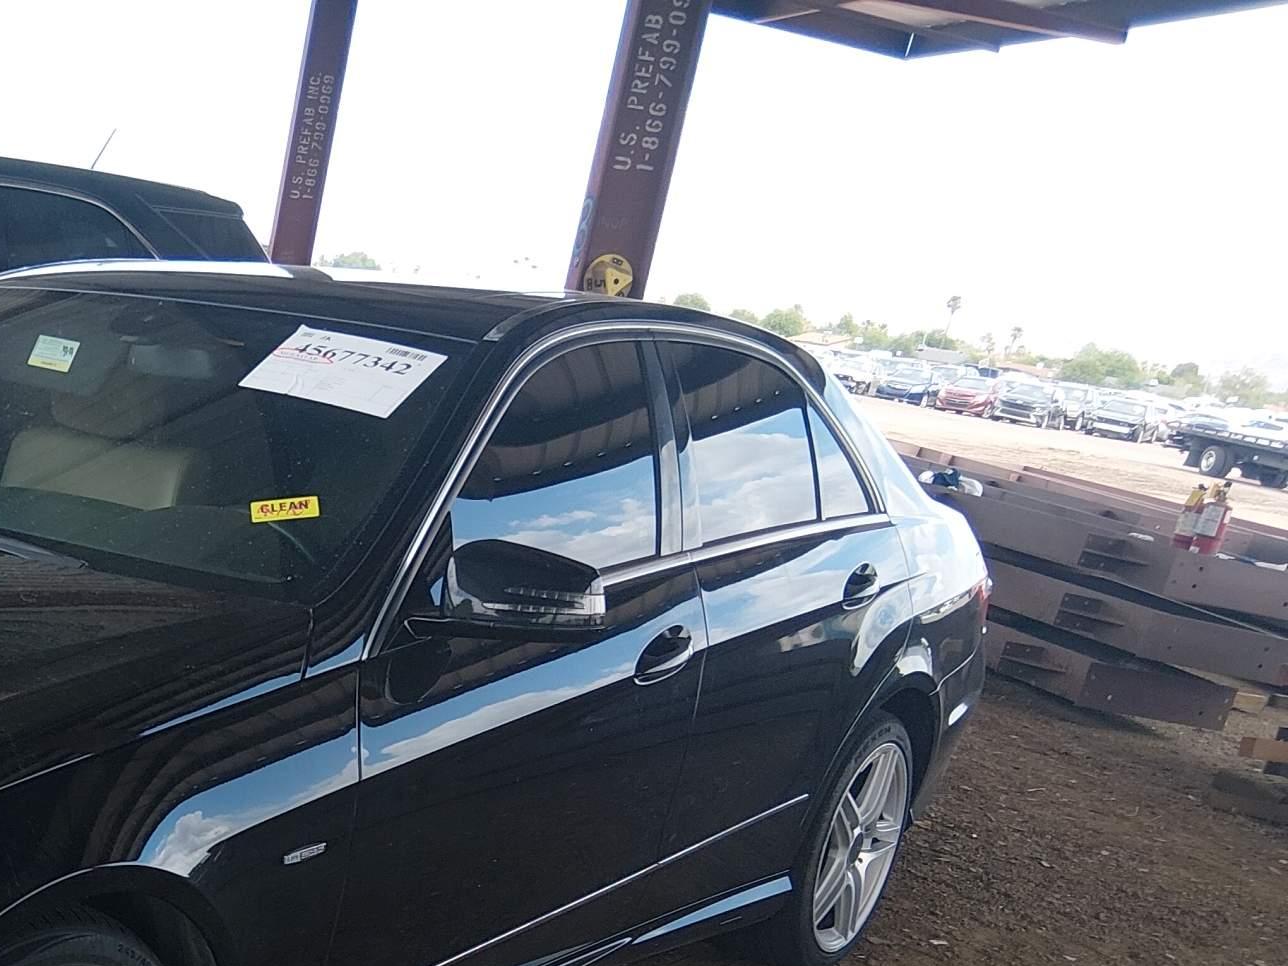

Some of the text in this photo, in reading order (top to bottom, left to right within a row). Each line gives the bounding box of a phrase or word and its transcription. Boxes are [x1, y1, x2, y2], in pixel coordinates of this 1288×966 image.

[613, 14, 663, 171] U.S. PREFAB
[289, 72, 323, 200] U.S. PREFAB INC.
[295, 343, 413, 375] 45677342
[260, 499, 310, 514] CLEAN
